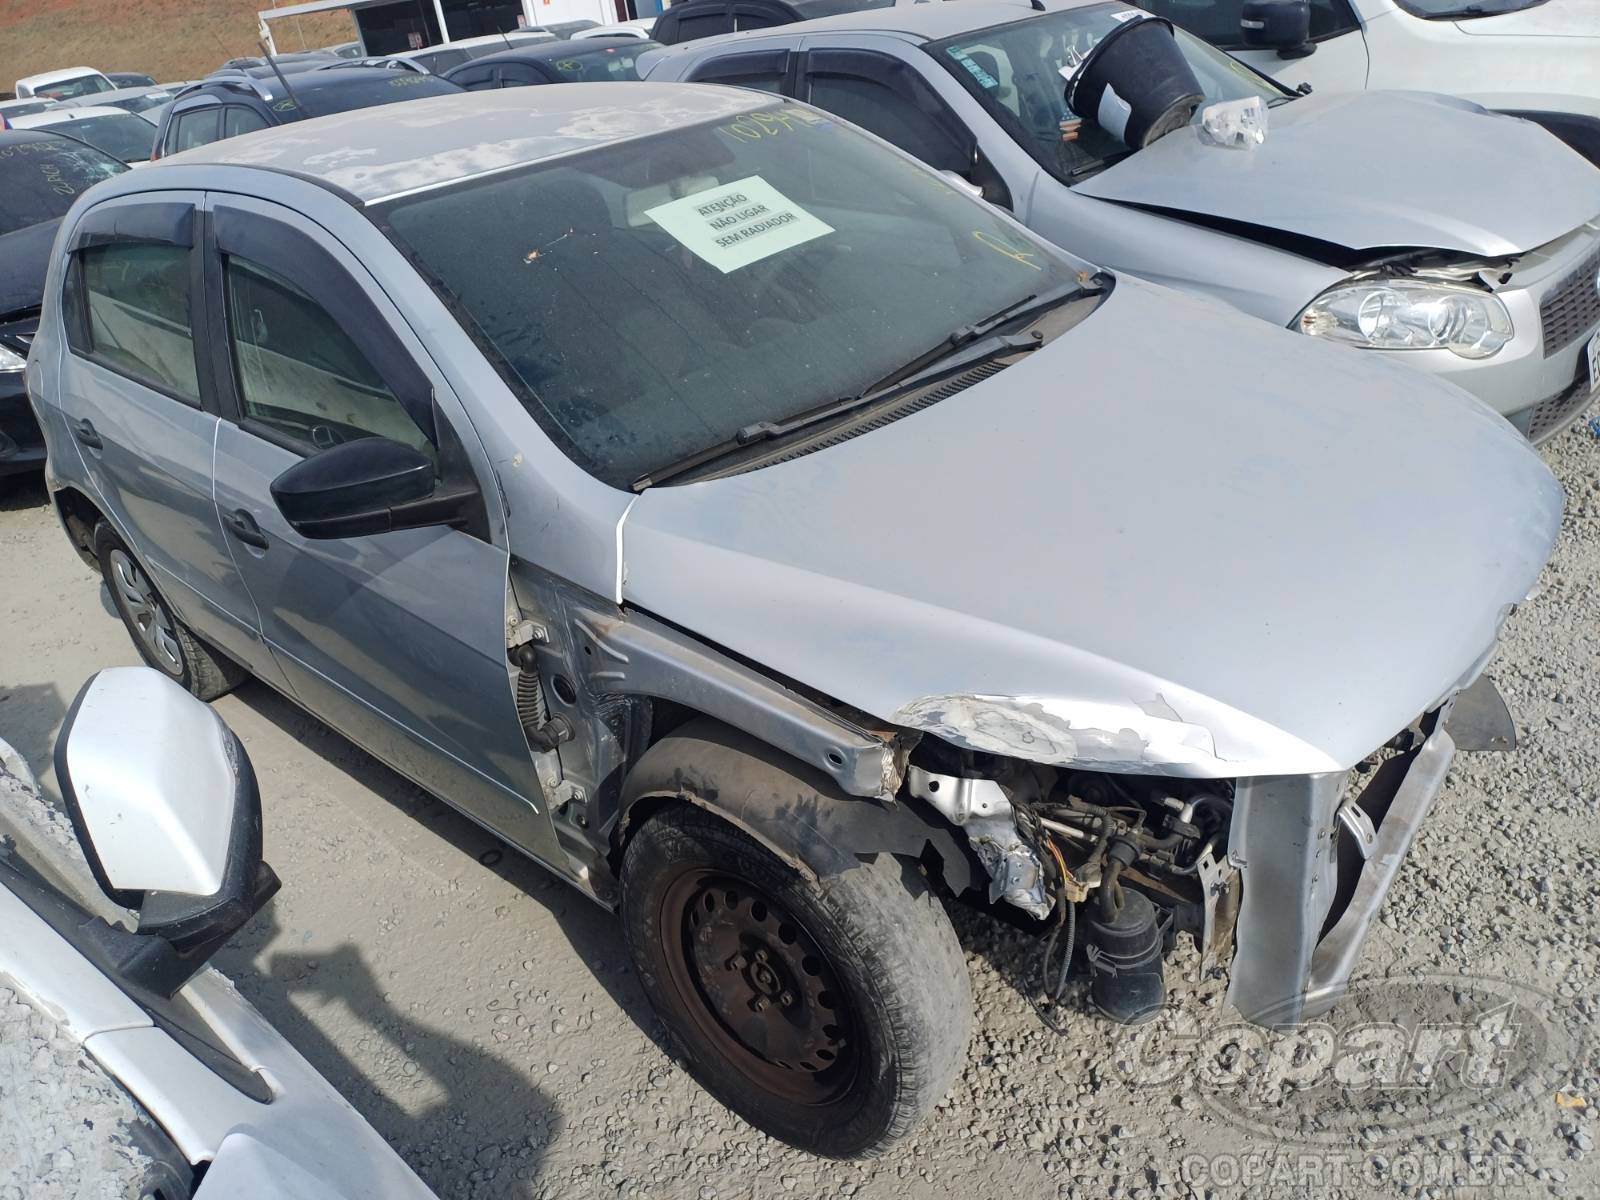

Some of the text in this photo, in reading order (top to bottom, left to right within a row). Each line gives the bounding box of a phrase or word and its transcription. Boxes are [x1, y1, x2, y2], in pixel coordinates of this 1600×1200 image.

[697, 193, 747, 217] ATENÇÃO
[709, 204, 769, 231] NÃO LIGAR
[715, 212, 796, 247] SEM RADIADOR
